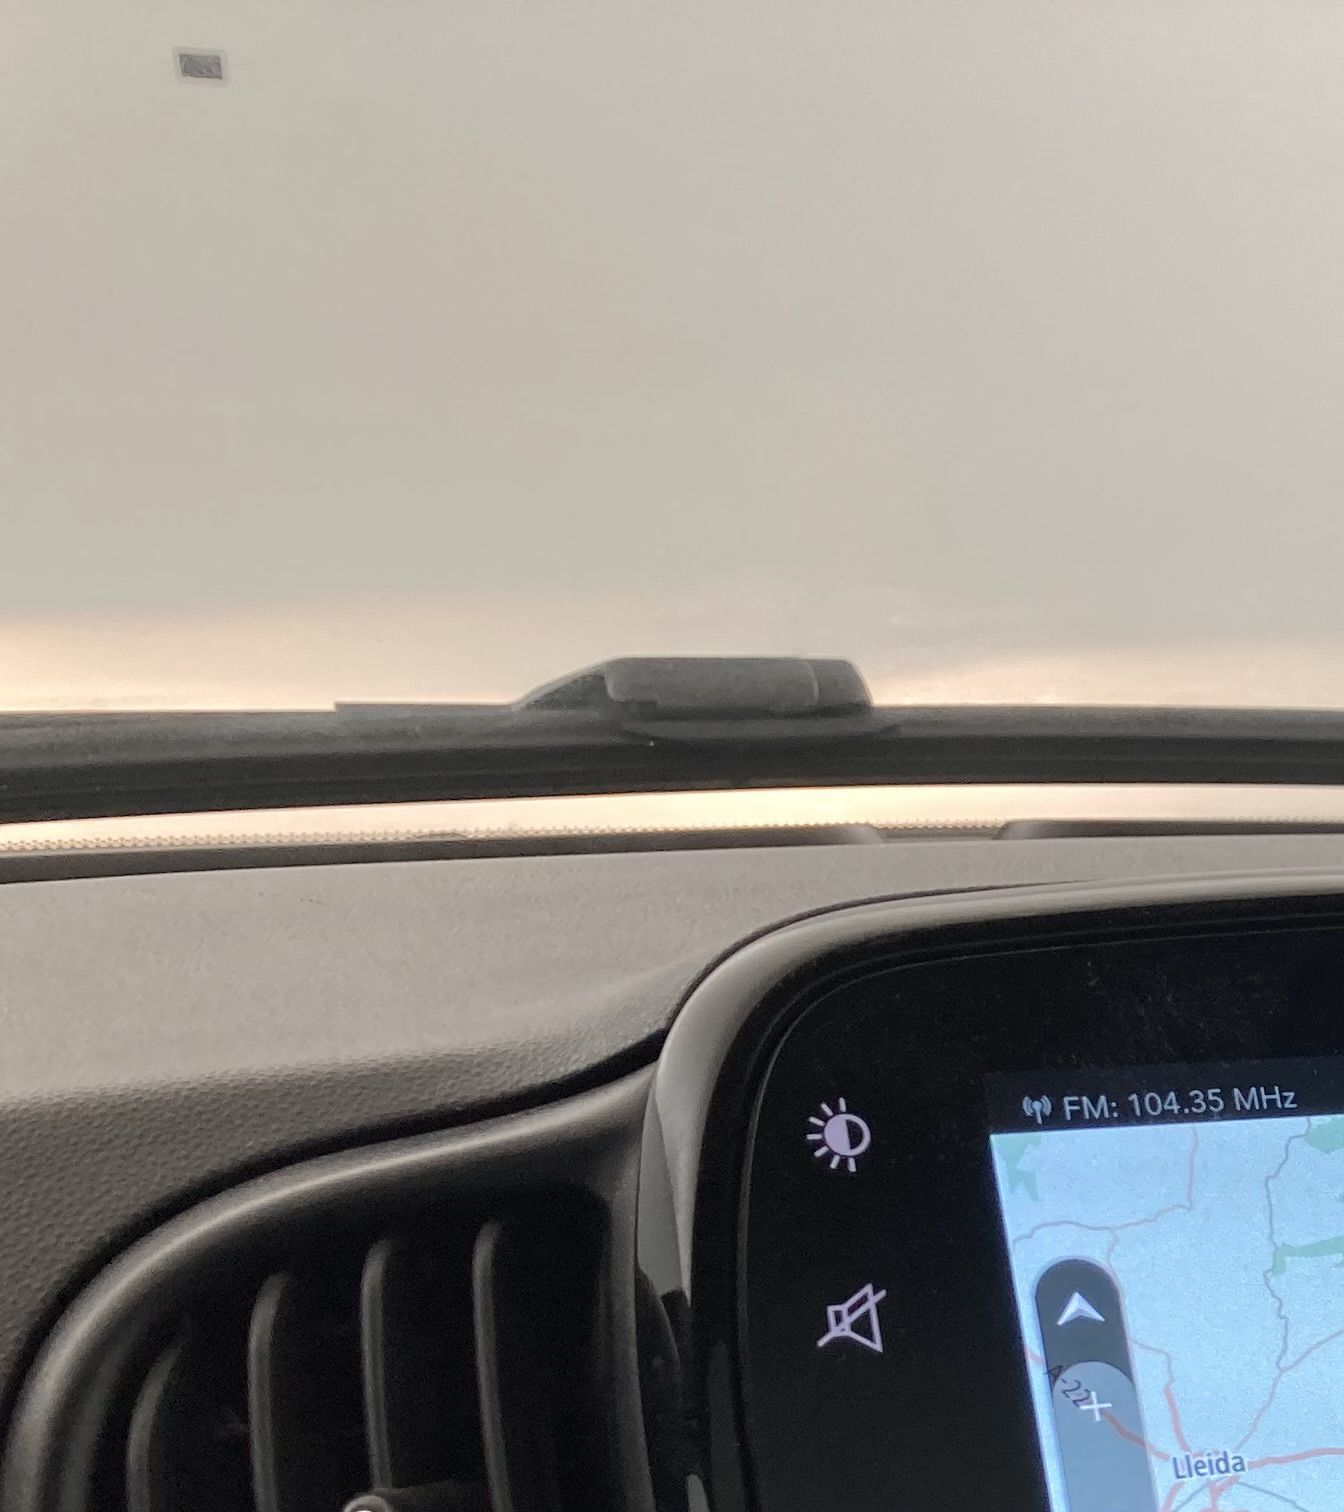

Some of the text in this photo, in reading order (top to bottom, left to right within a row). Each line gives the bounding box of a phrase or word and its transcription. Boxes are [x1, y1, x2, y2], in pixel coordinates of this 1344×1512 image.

[1063, 1085, 1298, 1121] FM: 104.35 MHz
[1172, 1451, 1247, 1480] Lleida
